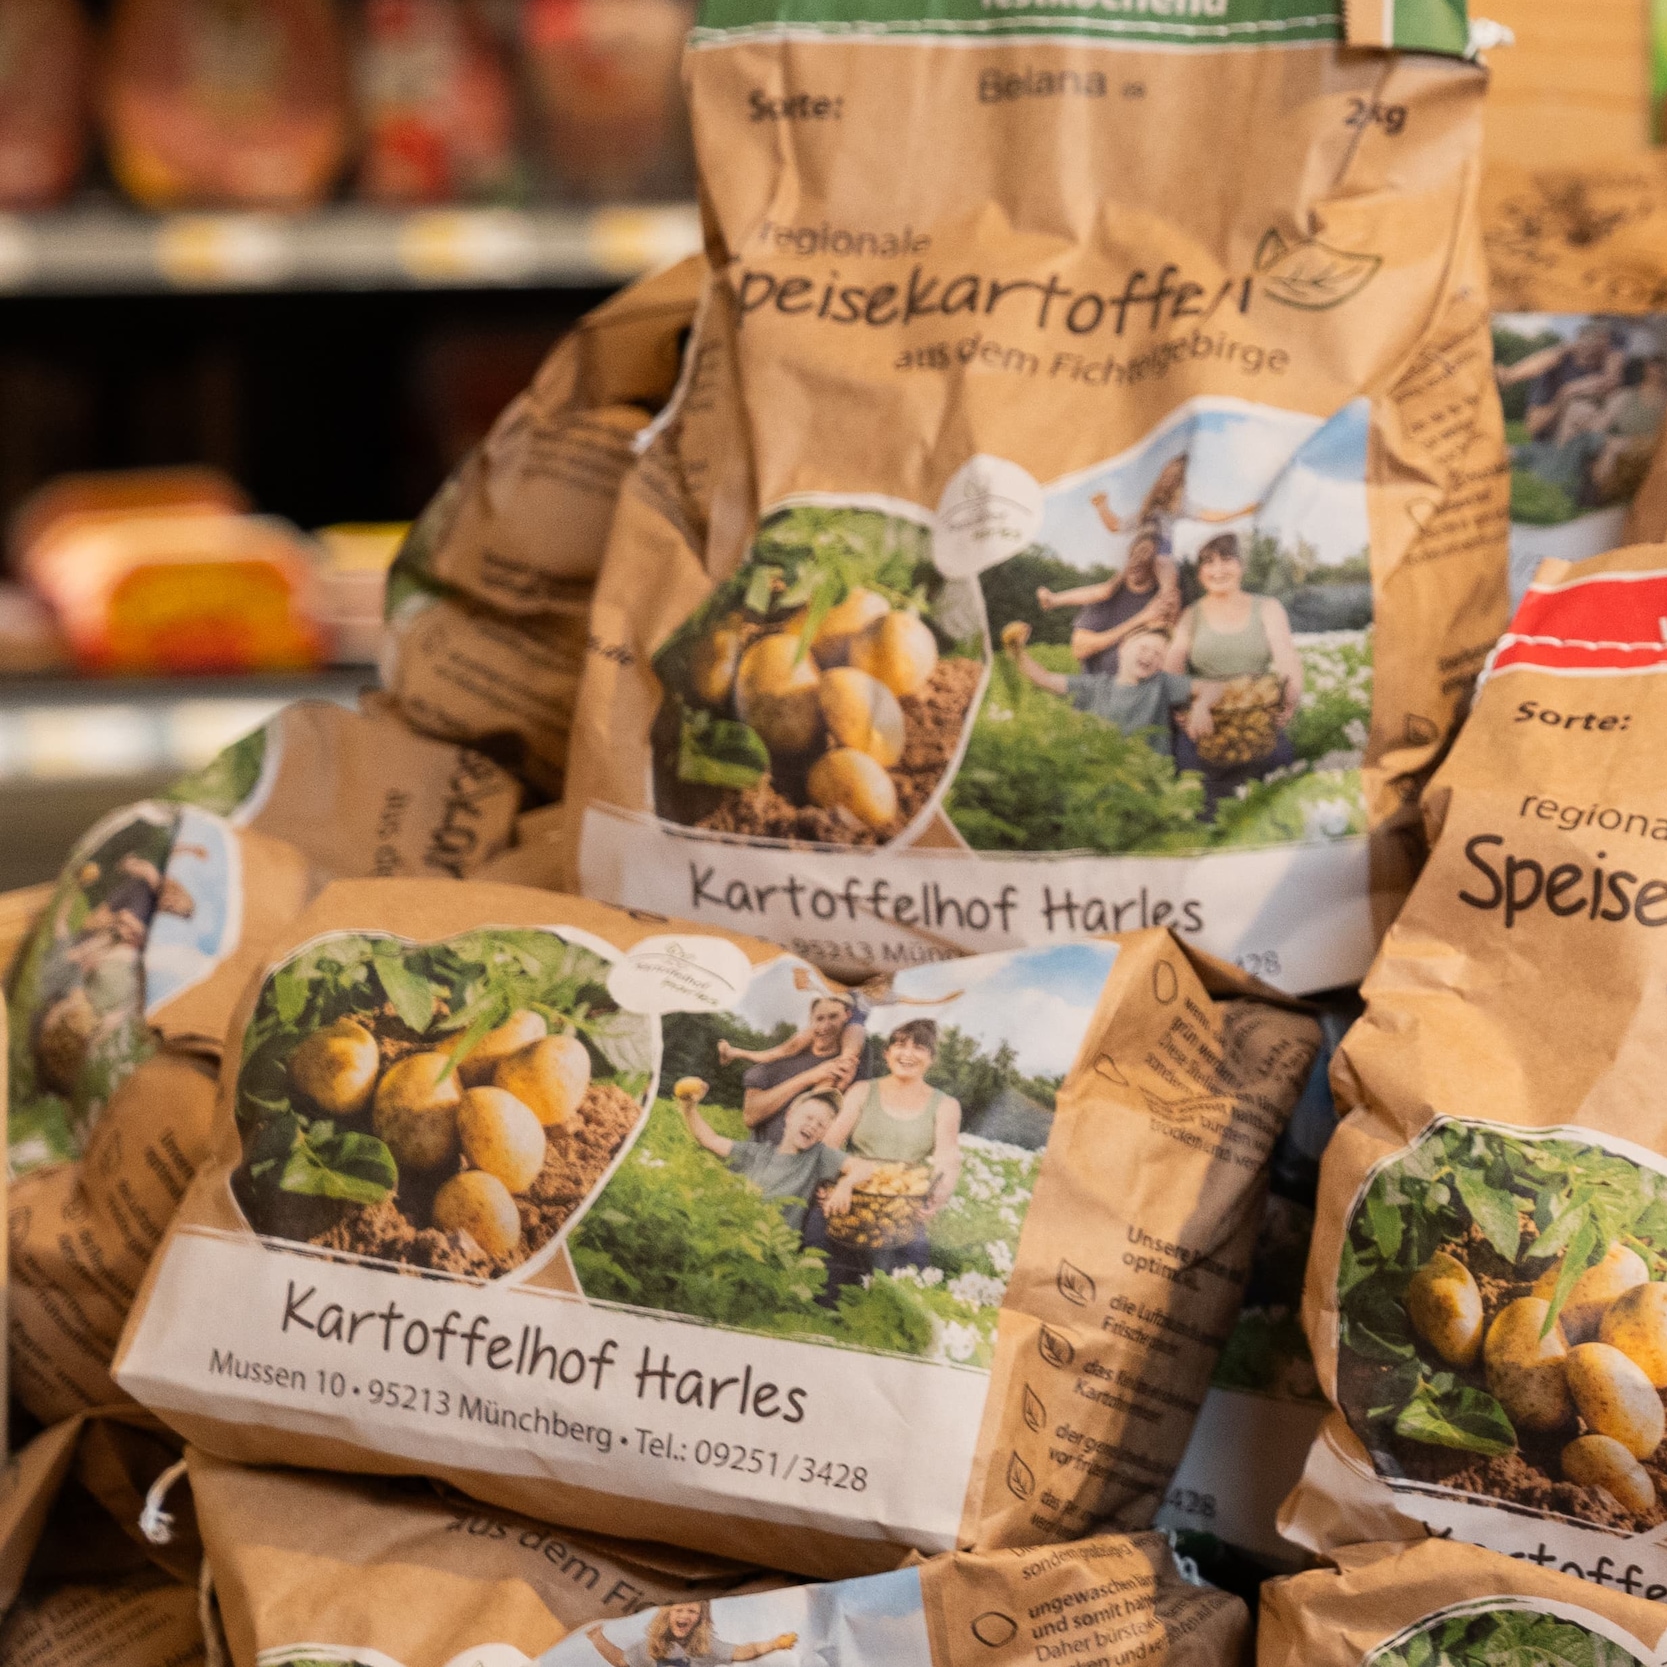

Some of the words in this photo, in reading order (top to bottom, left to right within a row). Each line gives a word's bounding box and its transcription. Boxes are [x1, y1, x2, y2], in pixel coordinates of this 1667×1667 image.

[977, 63, 1109, 106] Belana
[757, 221, 933, 261] regionale
[955, 332, 1038, 378] dem
[1513, 699, 1633, 735] Sorte:
[688, 860, 1020, 934] Kartoffelhof
[1042, 885, 1205, 935] Harles
[280, 1278, 620, 1391] Kartoffelhof
[635, 1345, 810, 1425] Harles
[208, 1347, 307, 1392] Mussen
[316, 1368, 347, 1398] 10
[366, 1378, 453, 1419] 95213
[457, 1391, 613, 1454] Münchberg
[634, 1425, 688, 1466] Tel.:
[518, 1528, 602, 1590] dem
[1027, 1576, 1137, 1620] ungewaschen
[1032, 1617, 1069, 1641] und
[1073, 1603, 1123, 1630] somit
[1035, 1637, 1091, 1663] Daher
